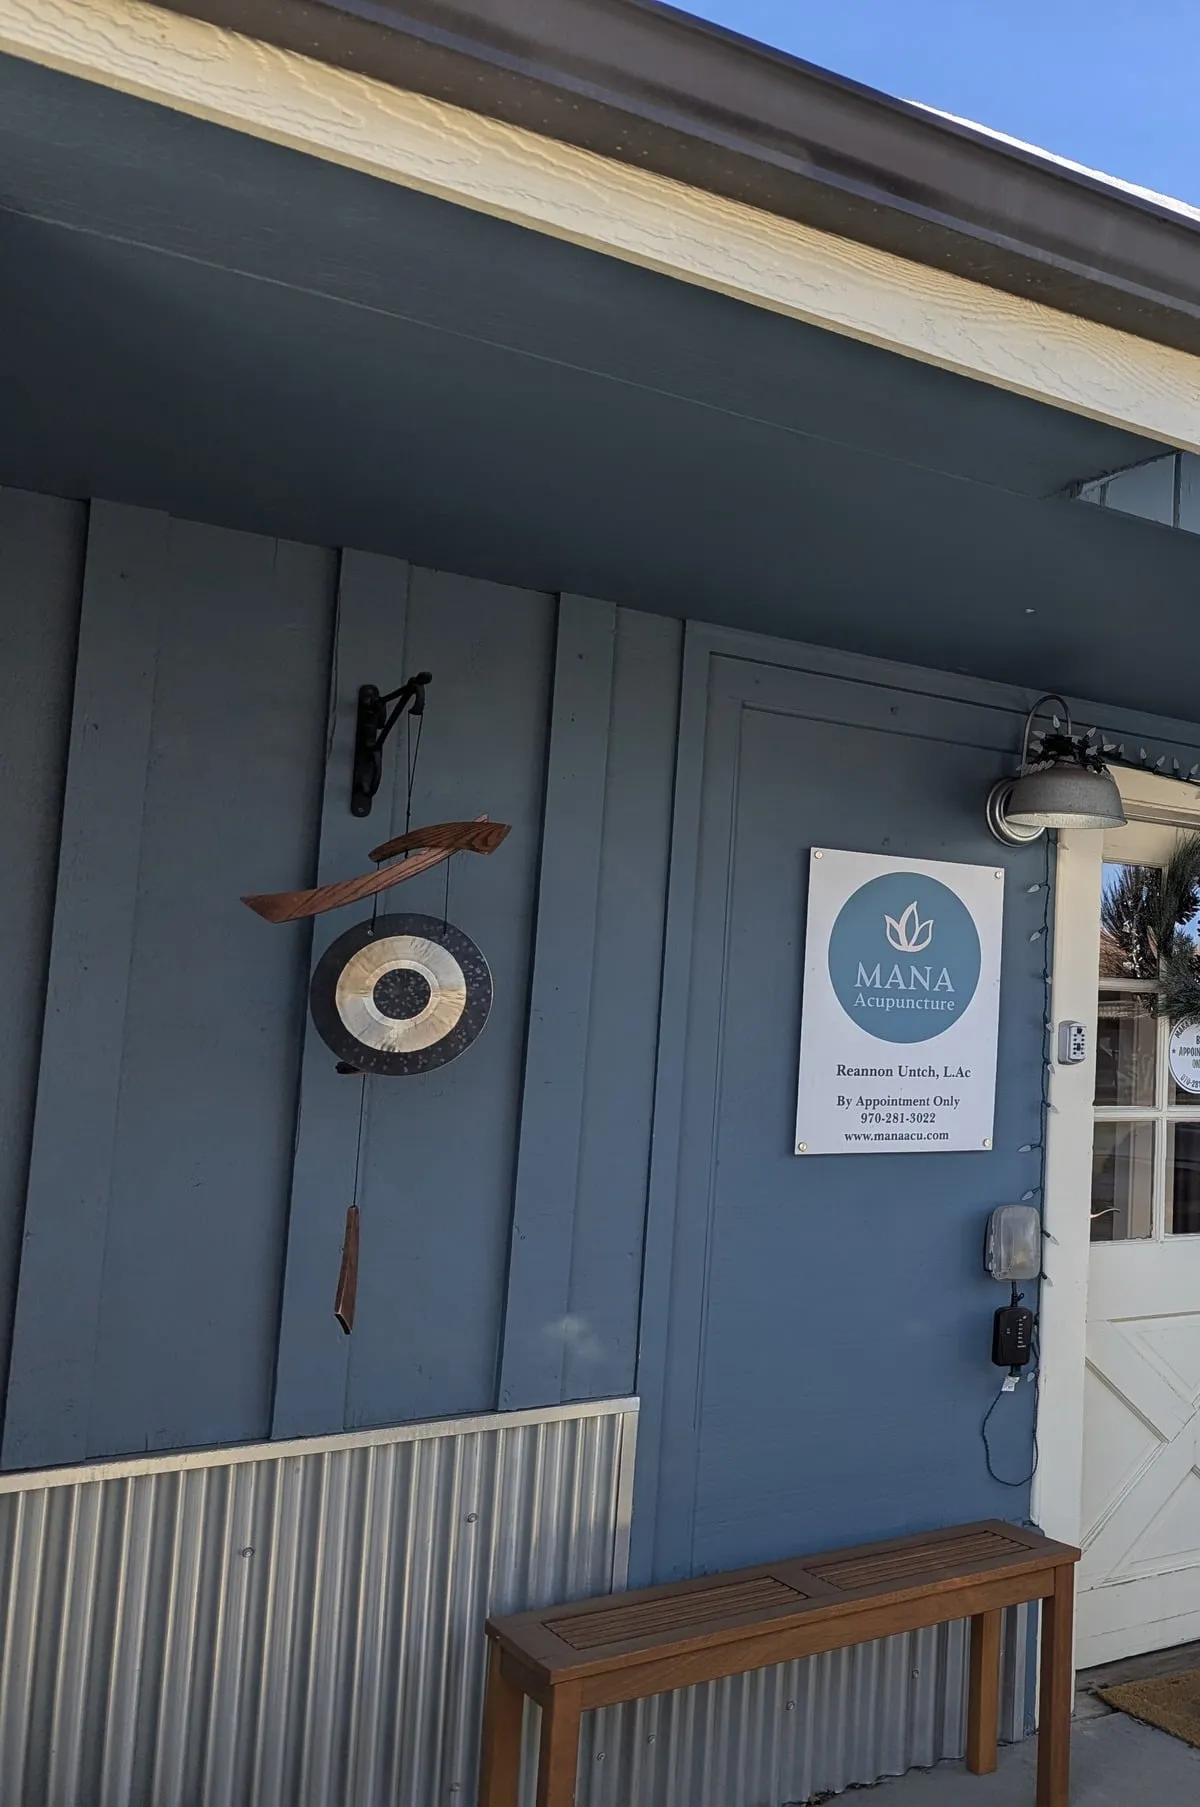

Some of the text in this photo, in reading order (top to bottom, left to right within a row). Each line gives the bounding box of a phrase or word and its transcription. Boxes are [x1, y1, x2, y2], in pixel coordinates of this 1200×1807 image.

[854, 962, 956, 993] MANA
[854, 992, 956, 1012] Acupuncture
[836, 1064, 972, 1079] Reannon Untch, L.Ac
[836, 1095, 961, 1110] By Appointment Only
[860, 1112, 936, 1124] 970-281-3022
[844, 1130, 950, 1142] www.manaacu.com
